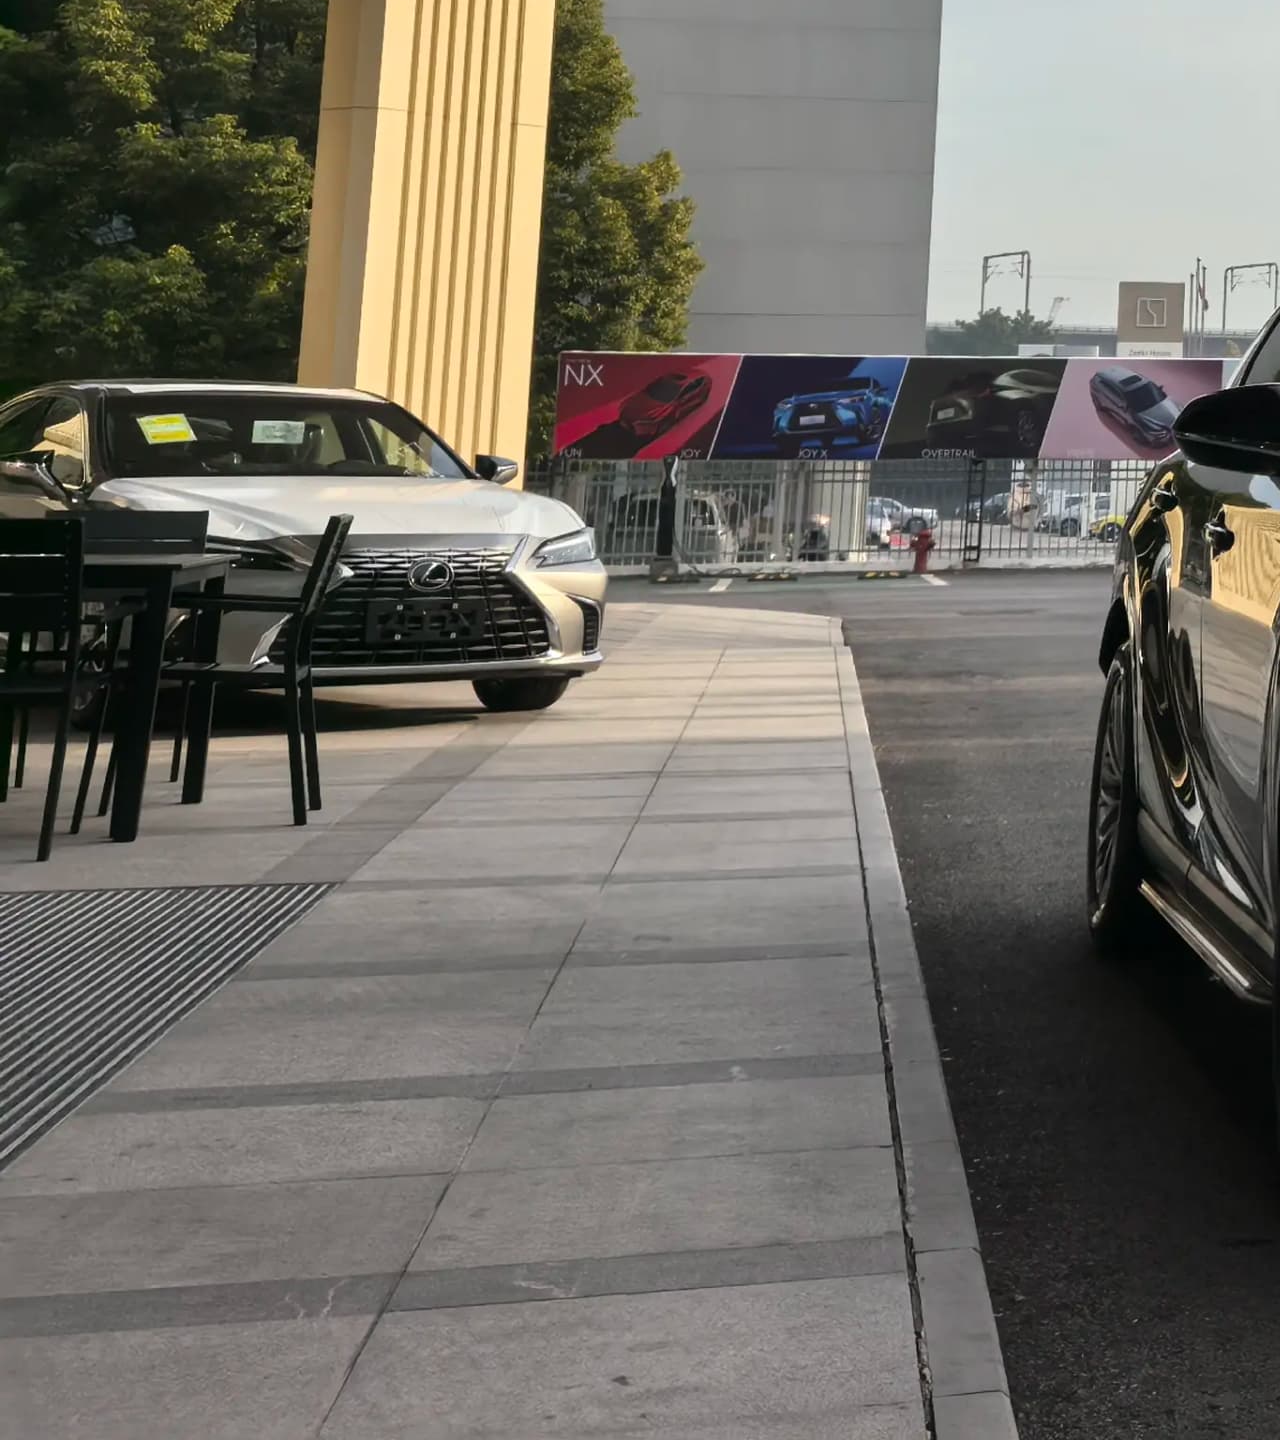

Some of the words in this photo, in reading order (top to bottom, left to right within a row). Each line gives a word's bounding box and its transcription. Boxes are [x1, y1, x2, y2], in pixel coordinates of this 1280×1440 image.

[564, 363, 604, 387] NX
[680, 448, 701, 459] JOY
[798, 448, 818, 459] JOY
[819, 448, 829, 459] X
[921, 447, 977, 459] OVERTRAIL
